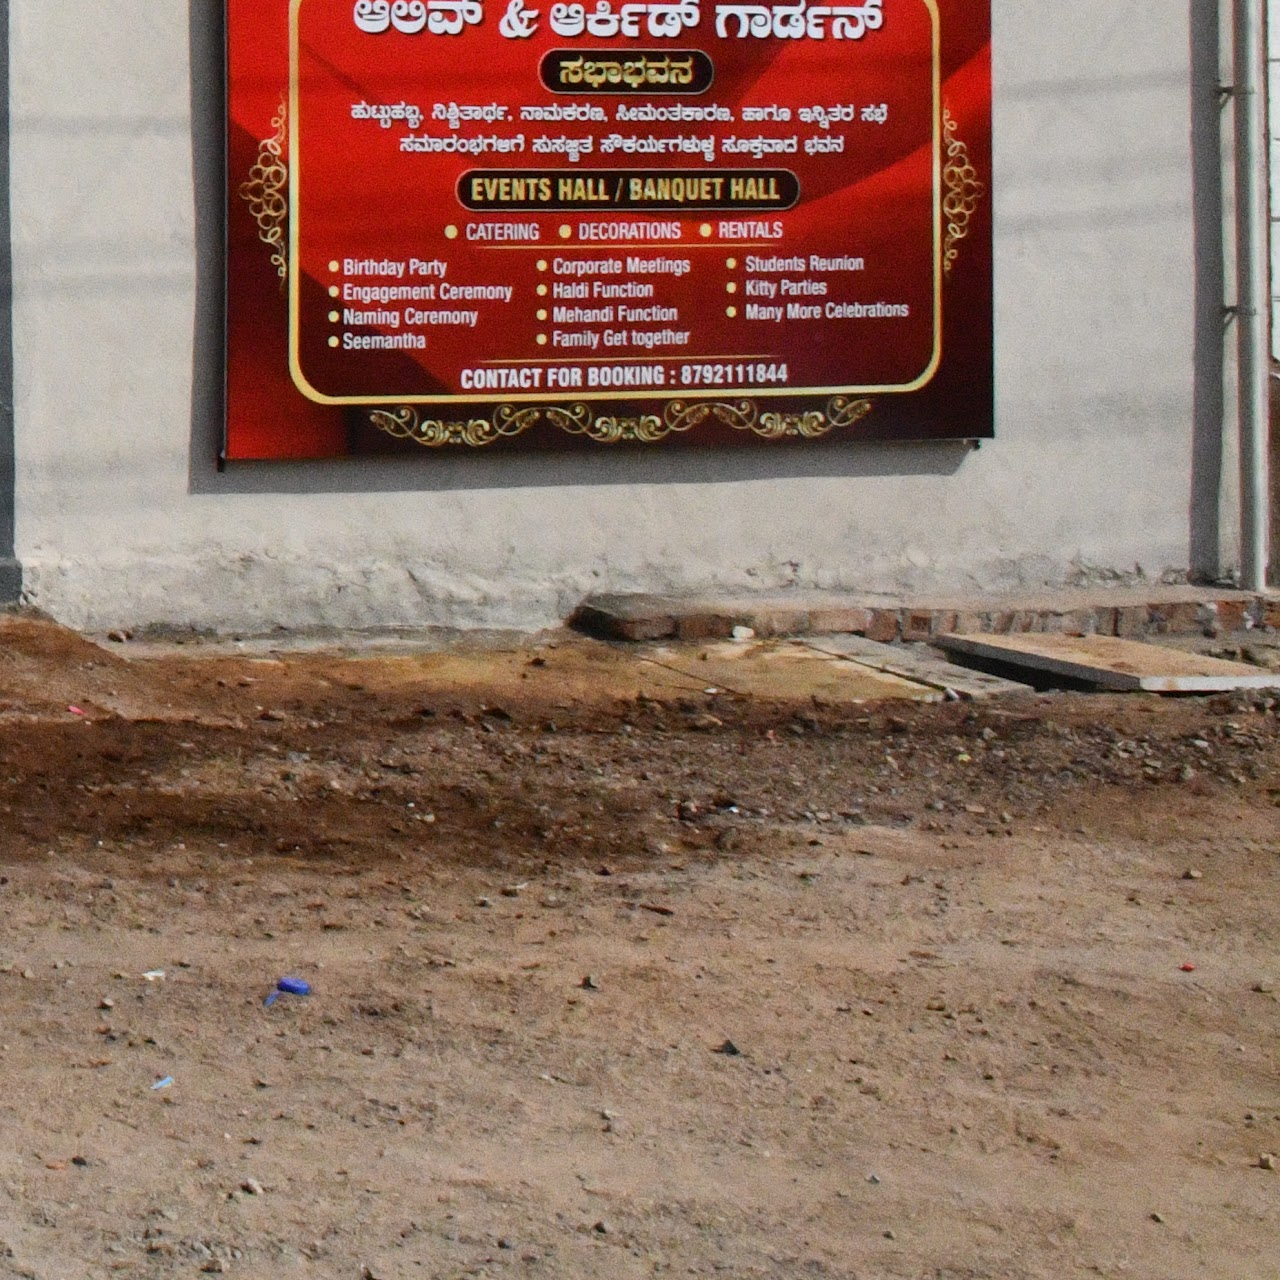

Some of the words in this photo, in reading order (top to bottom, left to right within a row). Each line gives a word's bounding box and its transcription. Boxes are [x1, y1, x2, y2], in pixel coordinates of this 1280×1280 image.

[559, 55, 693, 88] ಸಭಾಭವನ
[351, 100, 424, 128] ಹುಟ್ಟುಹಬ್ಬ,
[520, 103, 608, 122] ನಾಮಕರಣ,
[742, 104, 791, 121] ಹಾಗೂ
[798, 104, 854, 129] ಇನ್ನಿತರ
[861, 104, 888, 124] ಸಭೆ
[722, 135, 798, 158] ಸೂಕ್ತವಾದ
[804, 135, 844, 156] ಭವನ
[471, 178, 552, 201] EVENTS
[559, 178, 609, 200] HALL
[614, 177, 623, 202] /
[629, 177, 724, 202] BANQUET
[730, 177, 781, 200] HALL
[466, 223, 540, 241] CATERING
[579, 222, 681, 240] DECORATIONS
[719, 221, 783, 239] RENTALS
[343, 258, 405, 278] Birthday
[409, 258, 447, 278] Party
[553, 258, 622, 277] Corporate
[627, 256, 691, 276] Meetings
[745, 256, 806, 272] Students
[810, 255, 864, 271] Reunion
[343, 283, 435, 303] Engagement
[440, 282, 512, 302] Ceremony
[553, 282, 589, 298] Haldi
[593, 281, 654, 298] Function
[746, 280, 777, 298] Kitty
[781, 279, 828, 295] Parties
[343, 308, 400, 328] Naming
[404, 307, 478, 327] Ceremony
[553, 306, 613, 322] Mehandi
[618, 305, 678, 321] Function
[746, 303, 783, 322] Many
[787, 303, 821, 319] More
[825, 301, 909, 319] Celebrations
[343, 332, 426, 349] Seemantha
[552, 330, 599, 350] Family
[603, 329, 628, 346] Get
[631, 329, 690, 348] together
[461, 368, 542, 389] CONTACT
[547, 367, 582, 387] FOR
[588, 366, 665, 386] BOOKING
[670, 370, 676, 384] :
[681, 364, 787, 384] 8792111844
